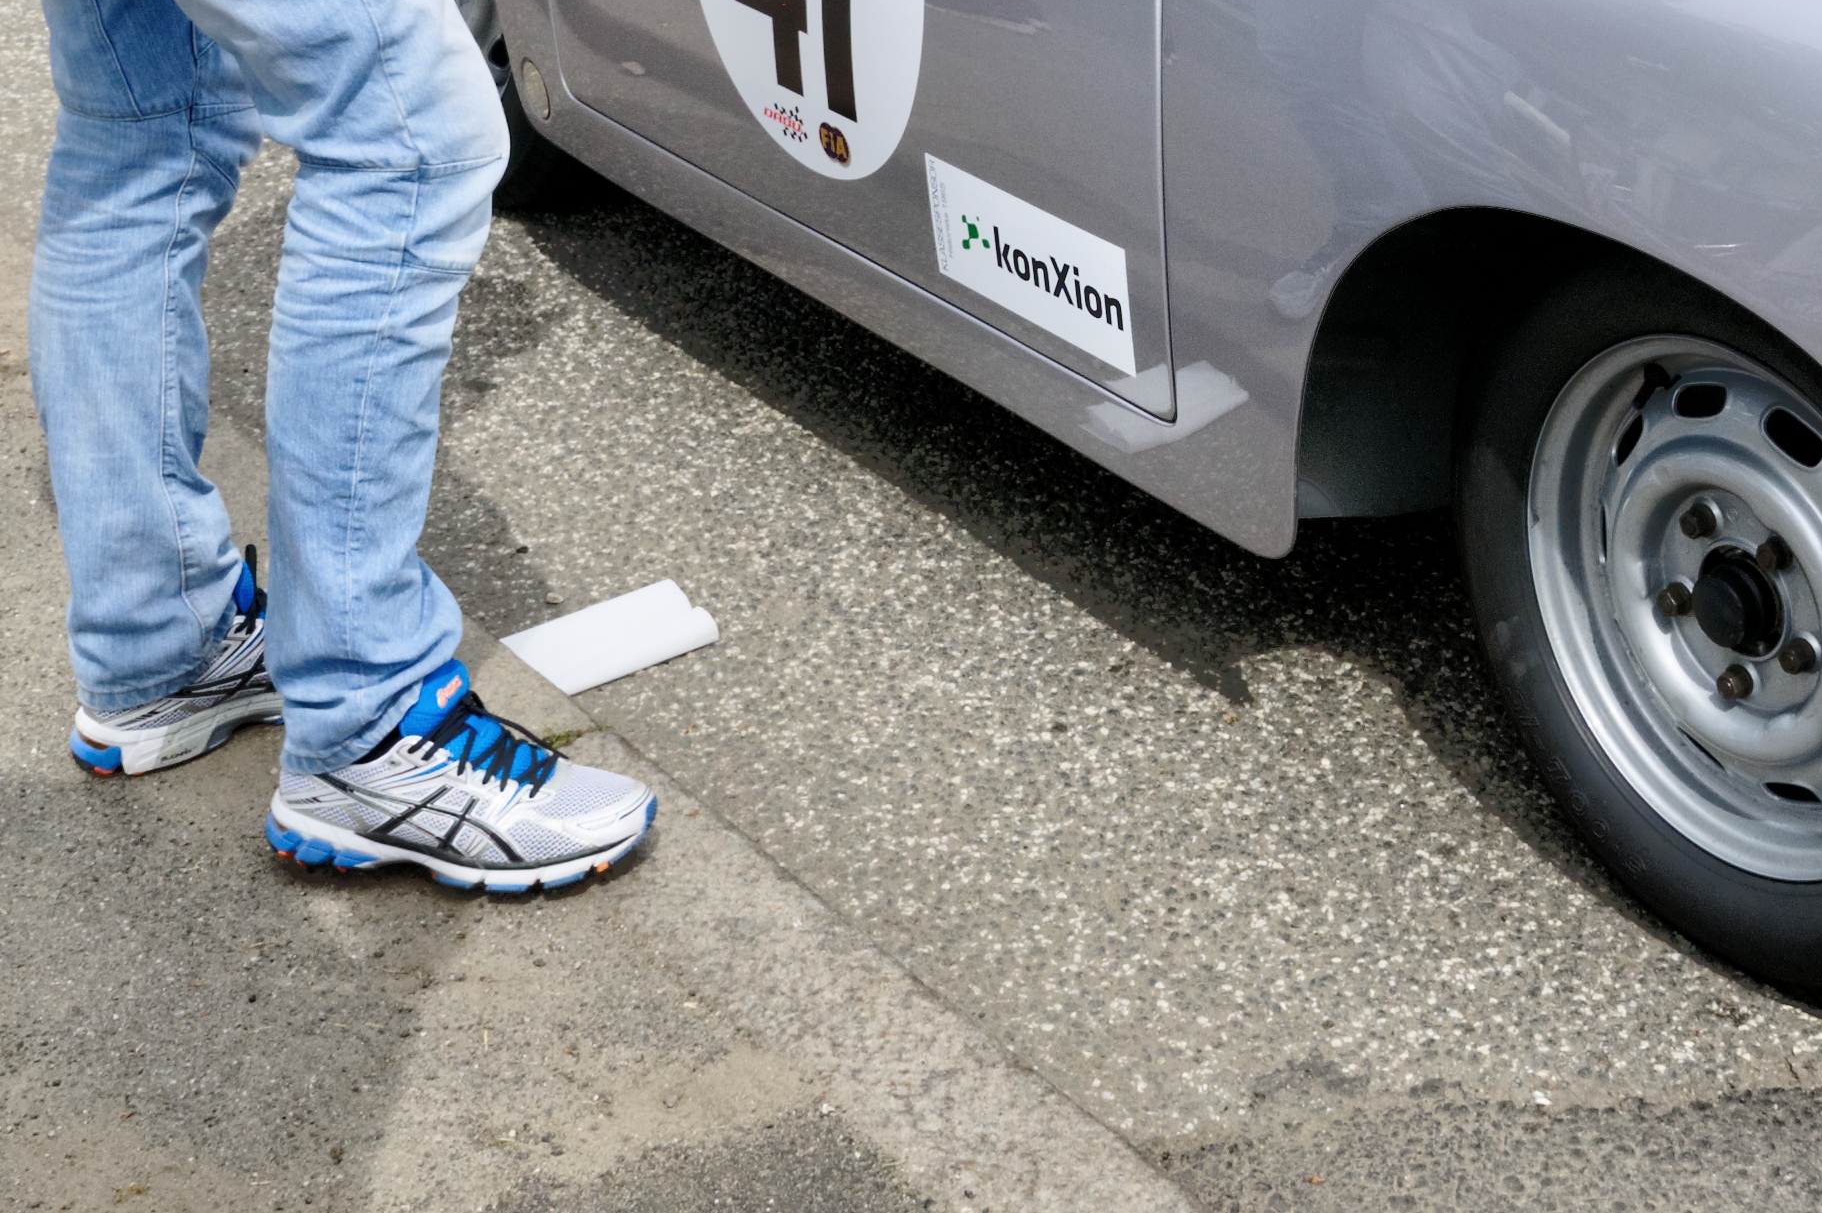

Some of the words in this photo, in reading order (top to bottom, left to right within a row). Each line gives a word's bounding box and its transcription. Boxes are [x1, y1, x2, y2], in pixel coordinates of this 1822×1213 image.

[820, 126, 848, 162] FIA
[928, 159, 949, 273] KLASSESPONSOR
[992, 225, 1124, 332] konXion
